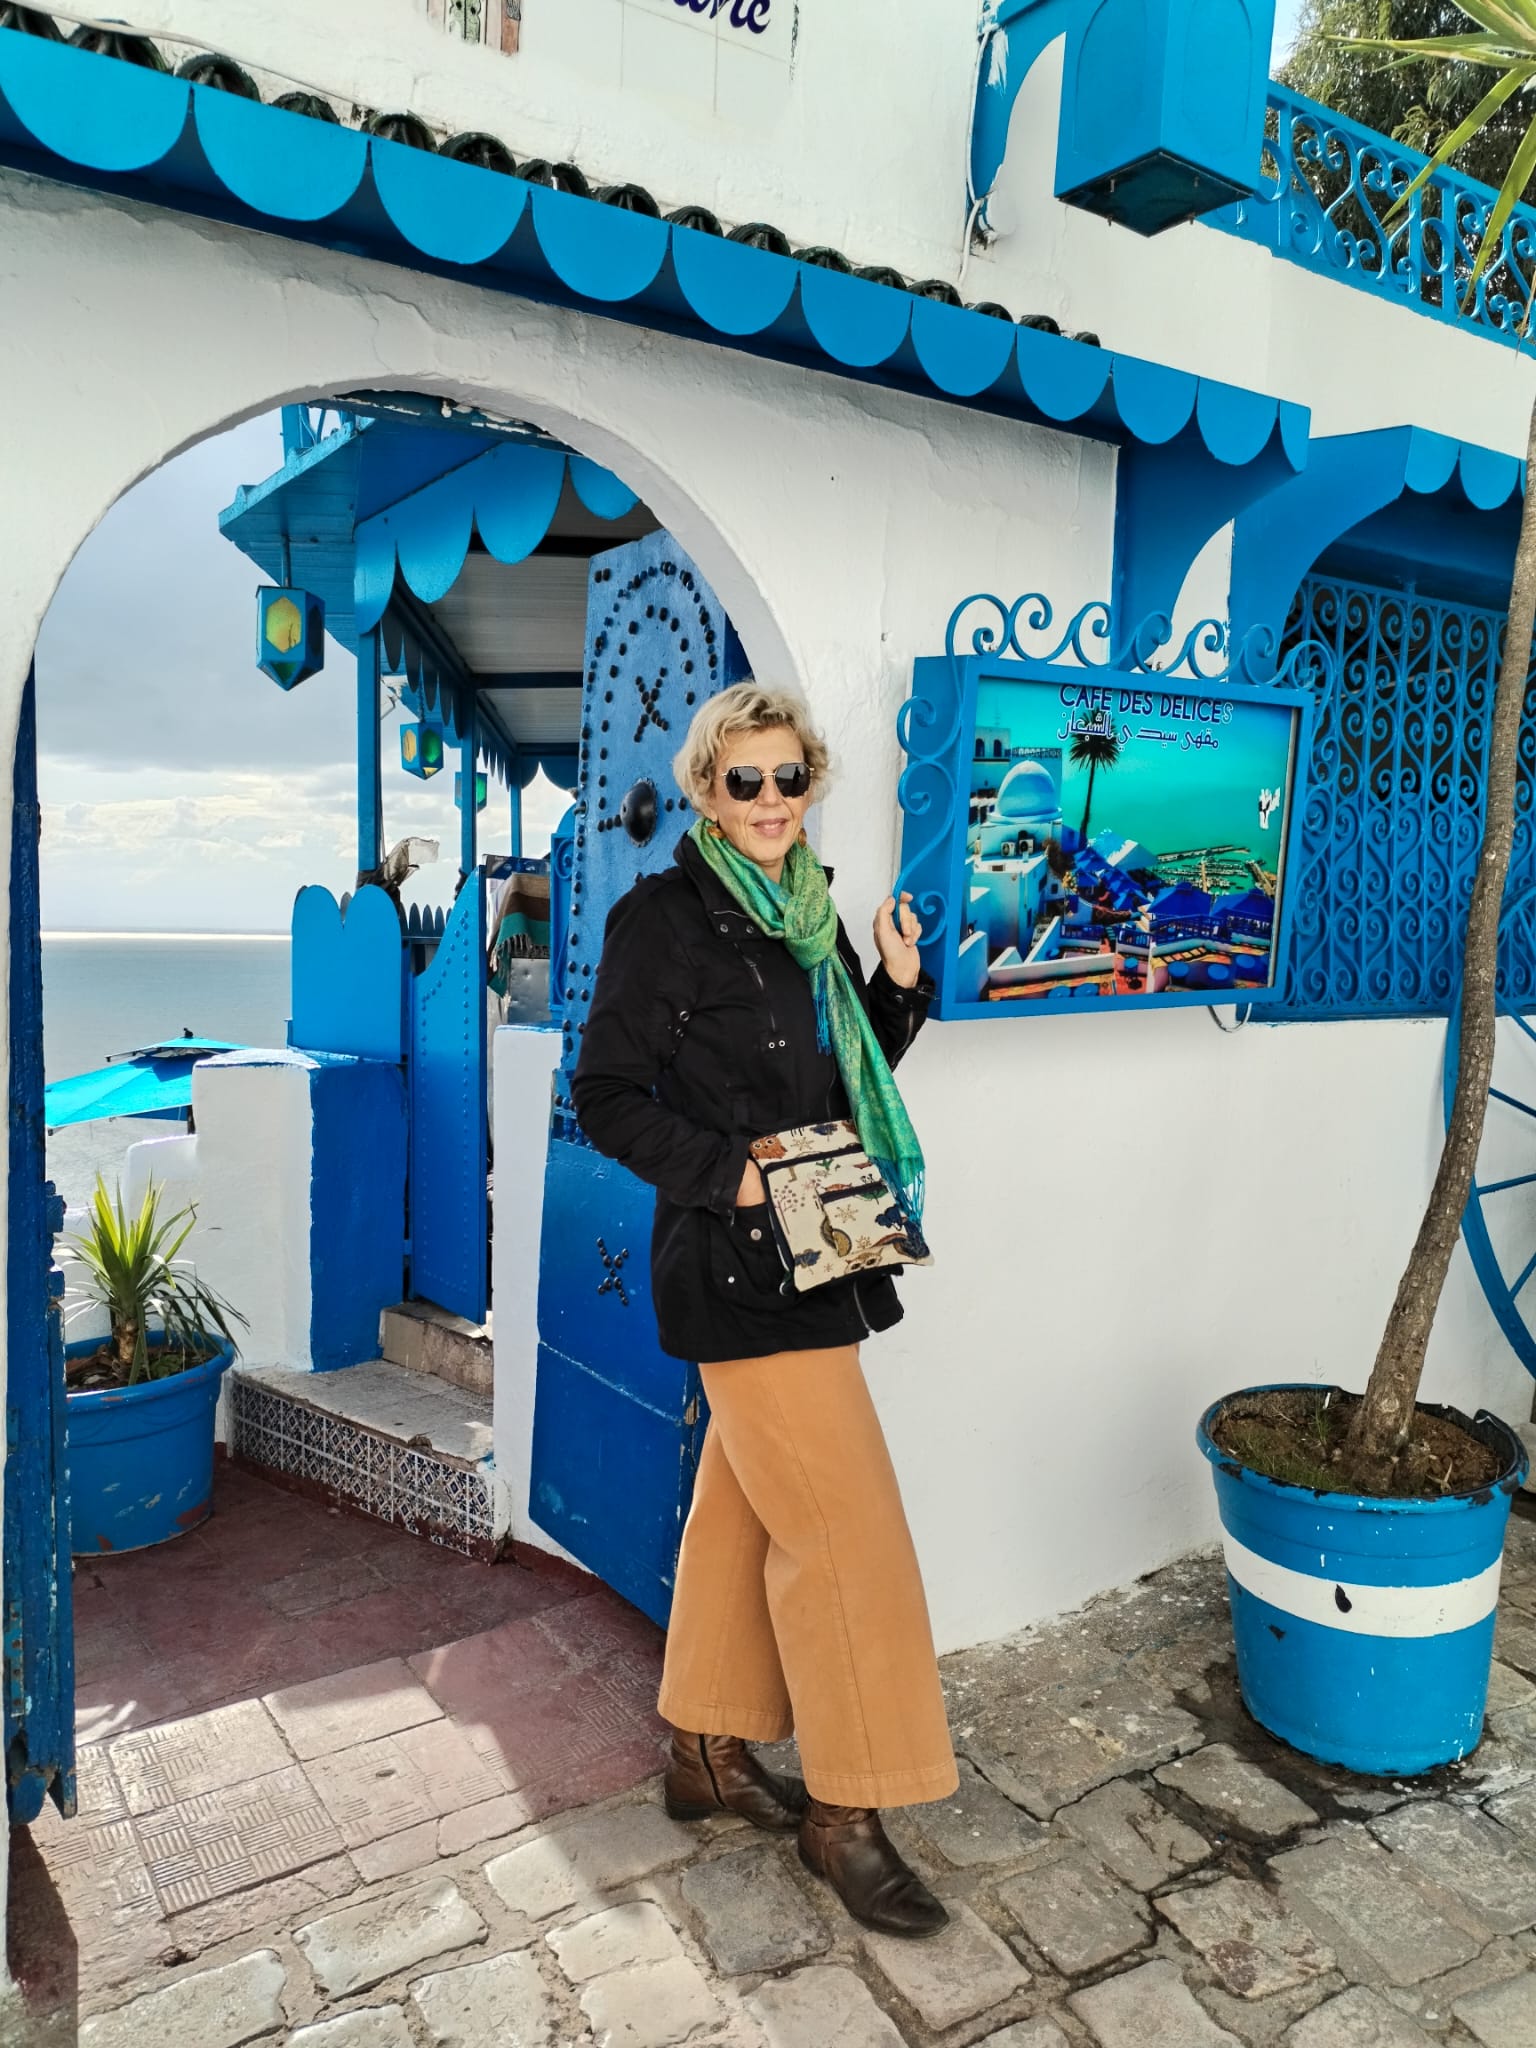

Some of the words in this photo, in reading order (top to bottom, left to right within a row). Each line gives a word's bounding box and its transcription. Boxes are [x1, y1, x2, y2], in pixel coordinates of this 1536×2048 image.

[1060, 684, 1112, 711] CAFE
[1118, 690, 1153, 716] DES
[1159, 697, 1233, 724] DELICES
[1057, 710, 1113, 741] الشبعان
[1115, 724, 1178, 751] سيدي
